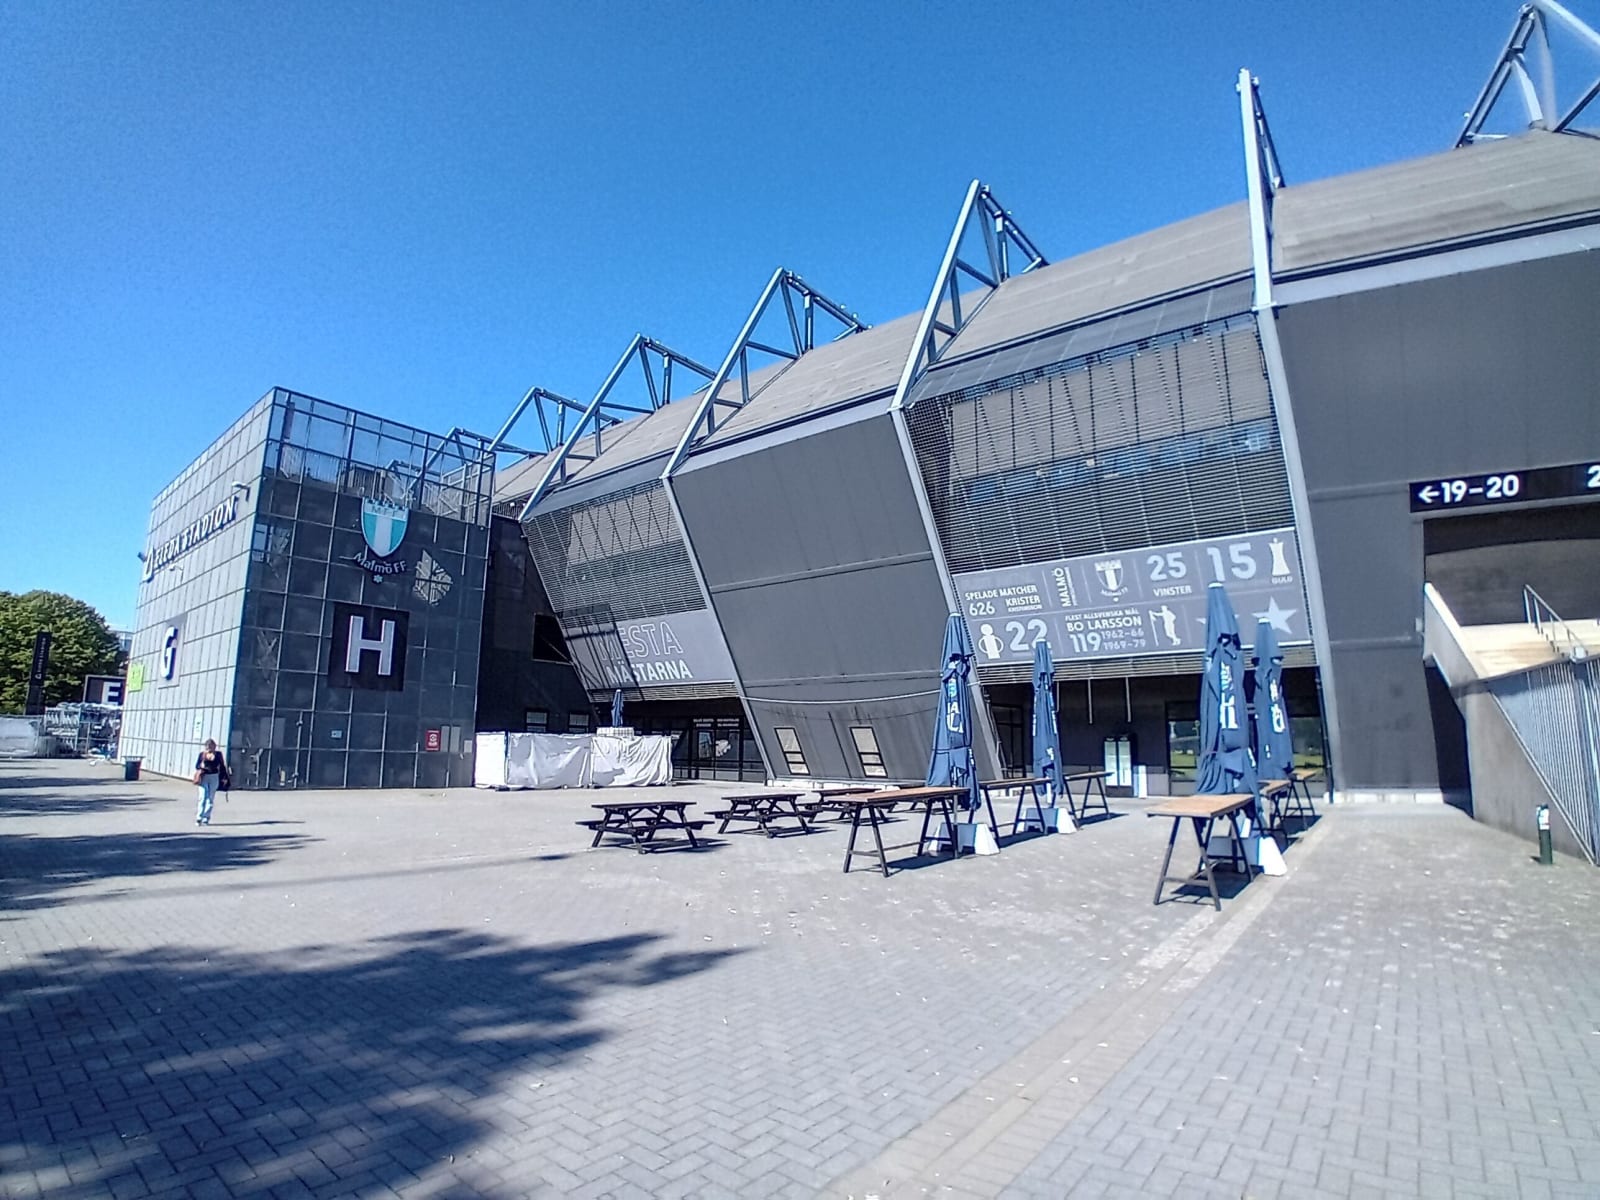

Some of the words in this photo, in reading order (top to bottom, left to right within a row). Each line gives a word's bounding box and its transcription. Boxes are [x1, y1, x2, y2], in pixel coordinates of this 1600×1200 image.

[1441, 474, 1519, 503] 19-20
[181, 496, 238, 550] STADION
[393, 560, 407, 573] FF
[1146, 551, 1187, 582] 25
[1206, 542, 1257, 582] 15
[965, 589, 998, 601] SPELADE
[999, 585, 1038, 597] MATCHER
[1051, 567, 1072, 607] MALMÖ
[1152, 585, 1192, 597] VINSTER
[969, 601, 996, 616] 626
[1005, 595, 1041, 607] KRISTER
[1005, 619, 1052, 651] 22
[1066, 621, 1084, 632] BO
[1088, 616, 1142, 630] LARSSON
[160, 626, 178, 679] G
[344, 615, 395, 676] H
[1069, 632, 1101, 653] 119
[101, 681, 121, 706] E
